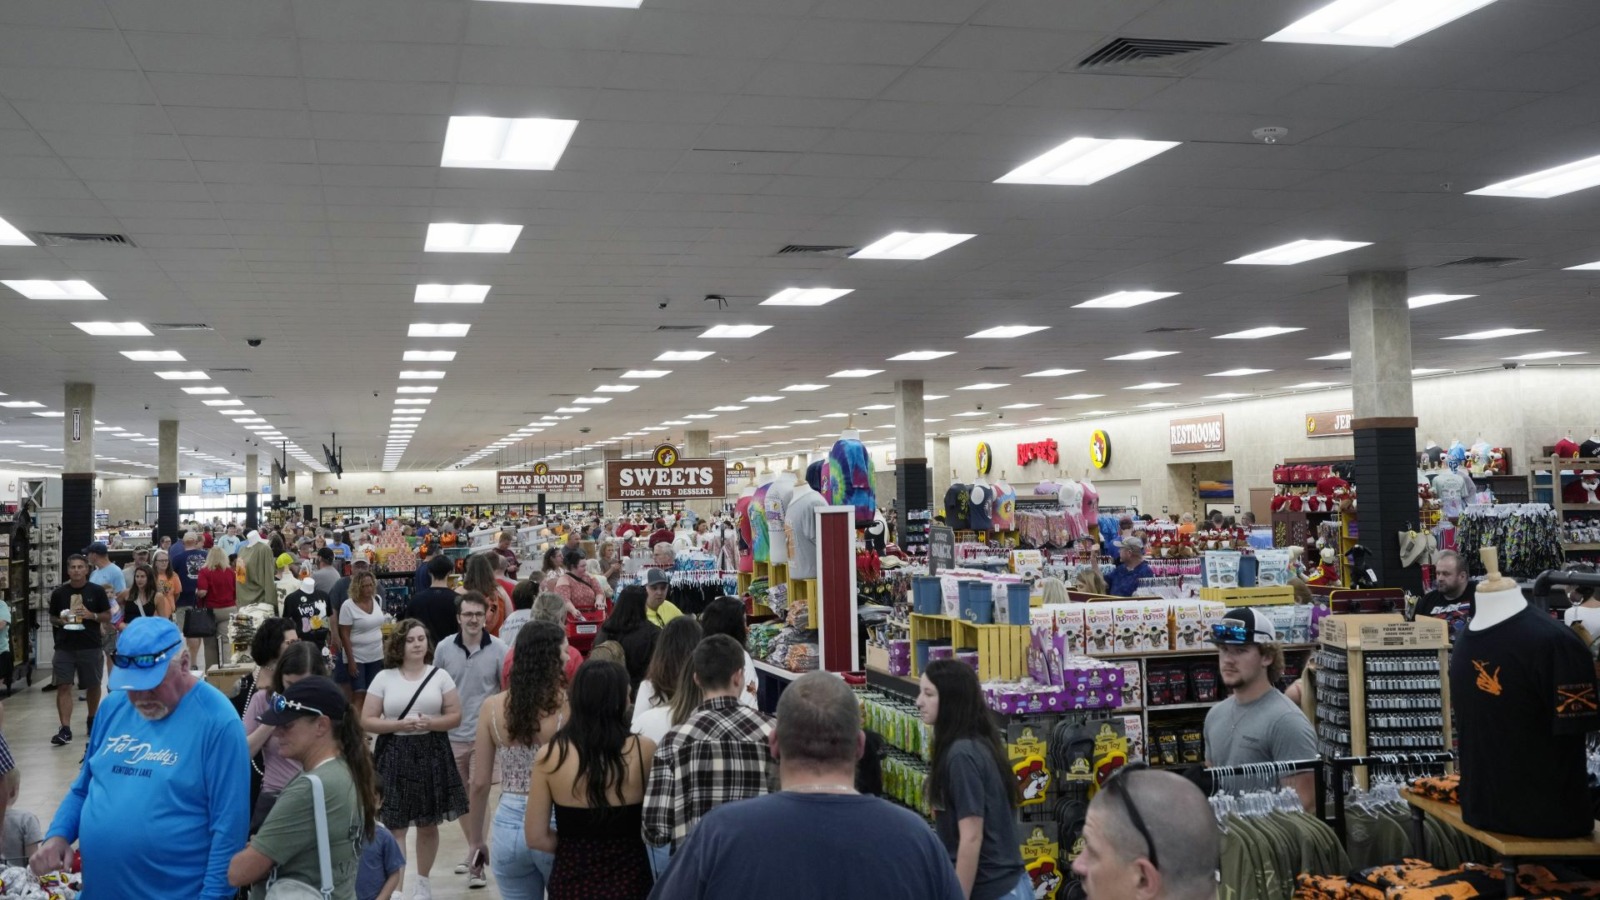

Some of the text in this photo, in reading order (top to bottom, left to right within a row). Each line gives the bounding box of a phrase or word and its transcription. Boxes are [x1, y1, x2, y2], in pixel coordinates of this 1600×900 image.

[1334, 414, 1354, 430] JER
[1170, 421, 1221, 445] RESTROOMS
[500, 474, 582, 485] TEXAS ROUND UP
[620, 467, 713, 486] SWEETS
[652, 488, 671, 496] NUTS
[1029, 617, 1050, 625] OPPERS
[1087, 614, 1110, 624] POPPERS
[1115, 614, 1139, 623] POPPERS
[1142, 612, 1165, 622] POPPERS
[1182, 732, 1201, 742] CHEW
[102, 734, 178, 766] Fat Daddy's
[1014, 746, 1040, 755] Dog Toy
[1095, 742, 1120, 751] Dog Toy
[112, 765, 153, 778] KENTUCKY LAKE
[1024, 846, 1052, 856] Dog Toy
